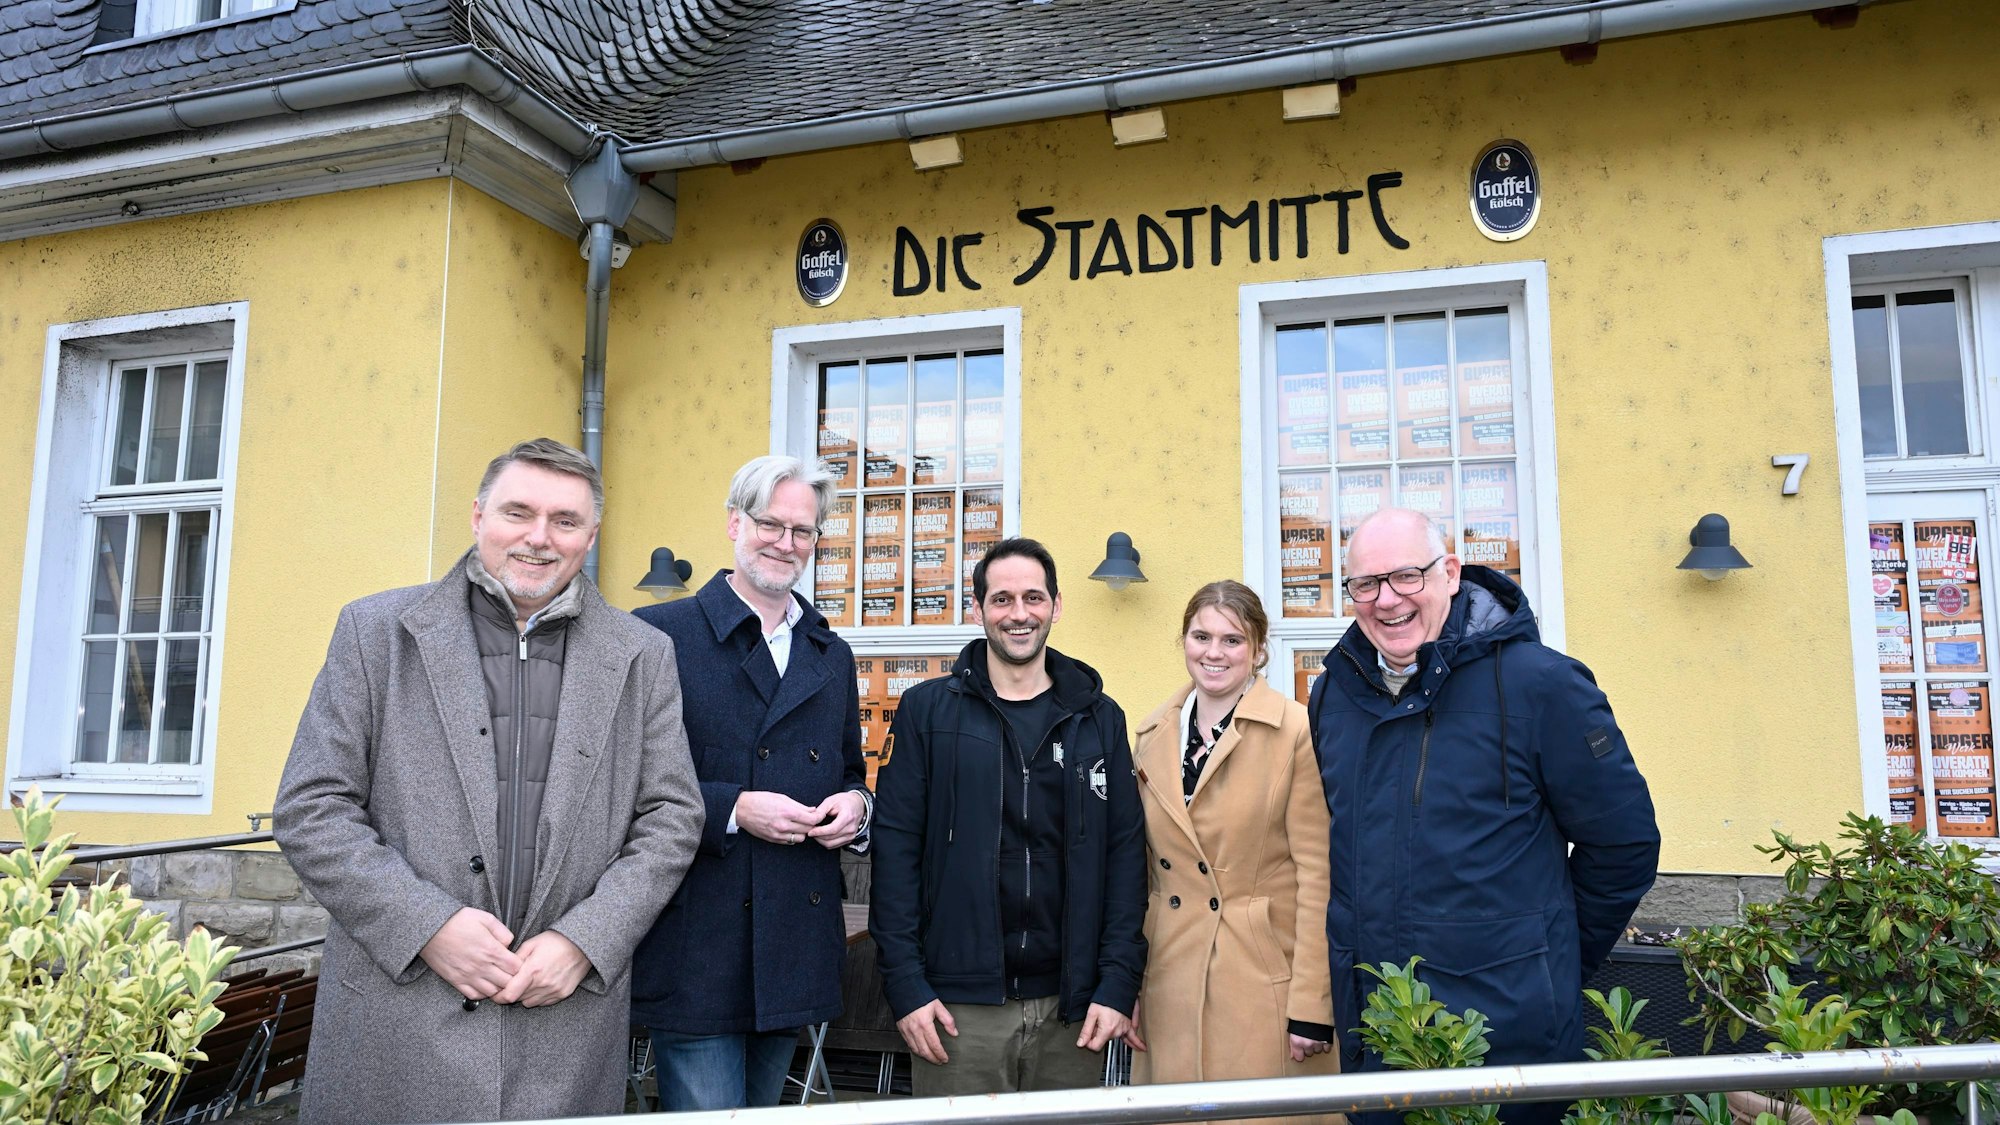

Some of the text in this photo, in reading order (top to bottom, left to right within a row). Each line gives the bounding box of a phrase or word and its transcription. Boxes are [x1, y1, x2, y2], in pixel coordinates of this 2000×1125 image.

[1478, 175, 1533, 199] Gaffel
[893, 170, 1410, 297] DIE STADTMITTE
[801, 249, 843, 270] Gaffel
[1771, 453, 1809, 496] 7
[820, 518, 849, 530] VERATH
[884, 660, 928, 673] BURGER
[1944, 742, 1975, 755] Werk
[1933, 756, 1989, 769] OVERATH
